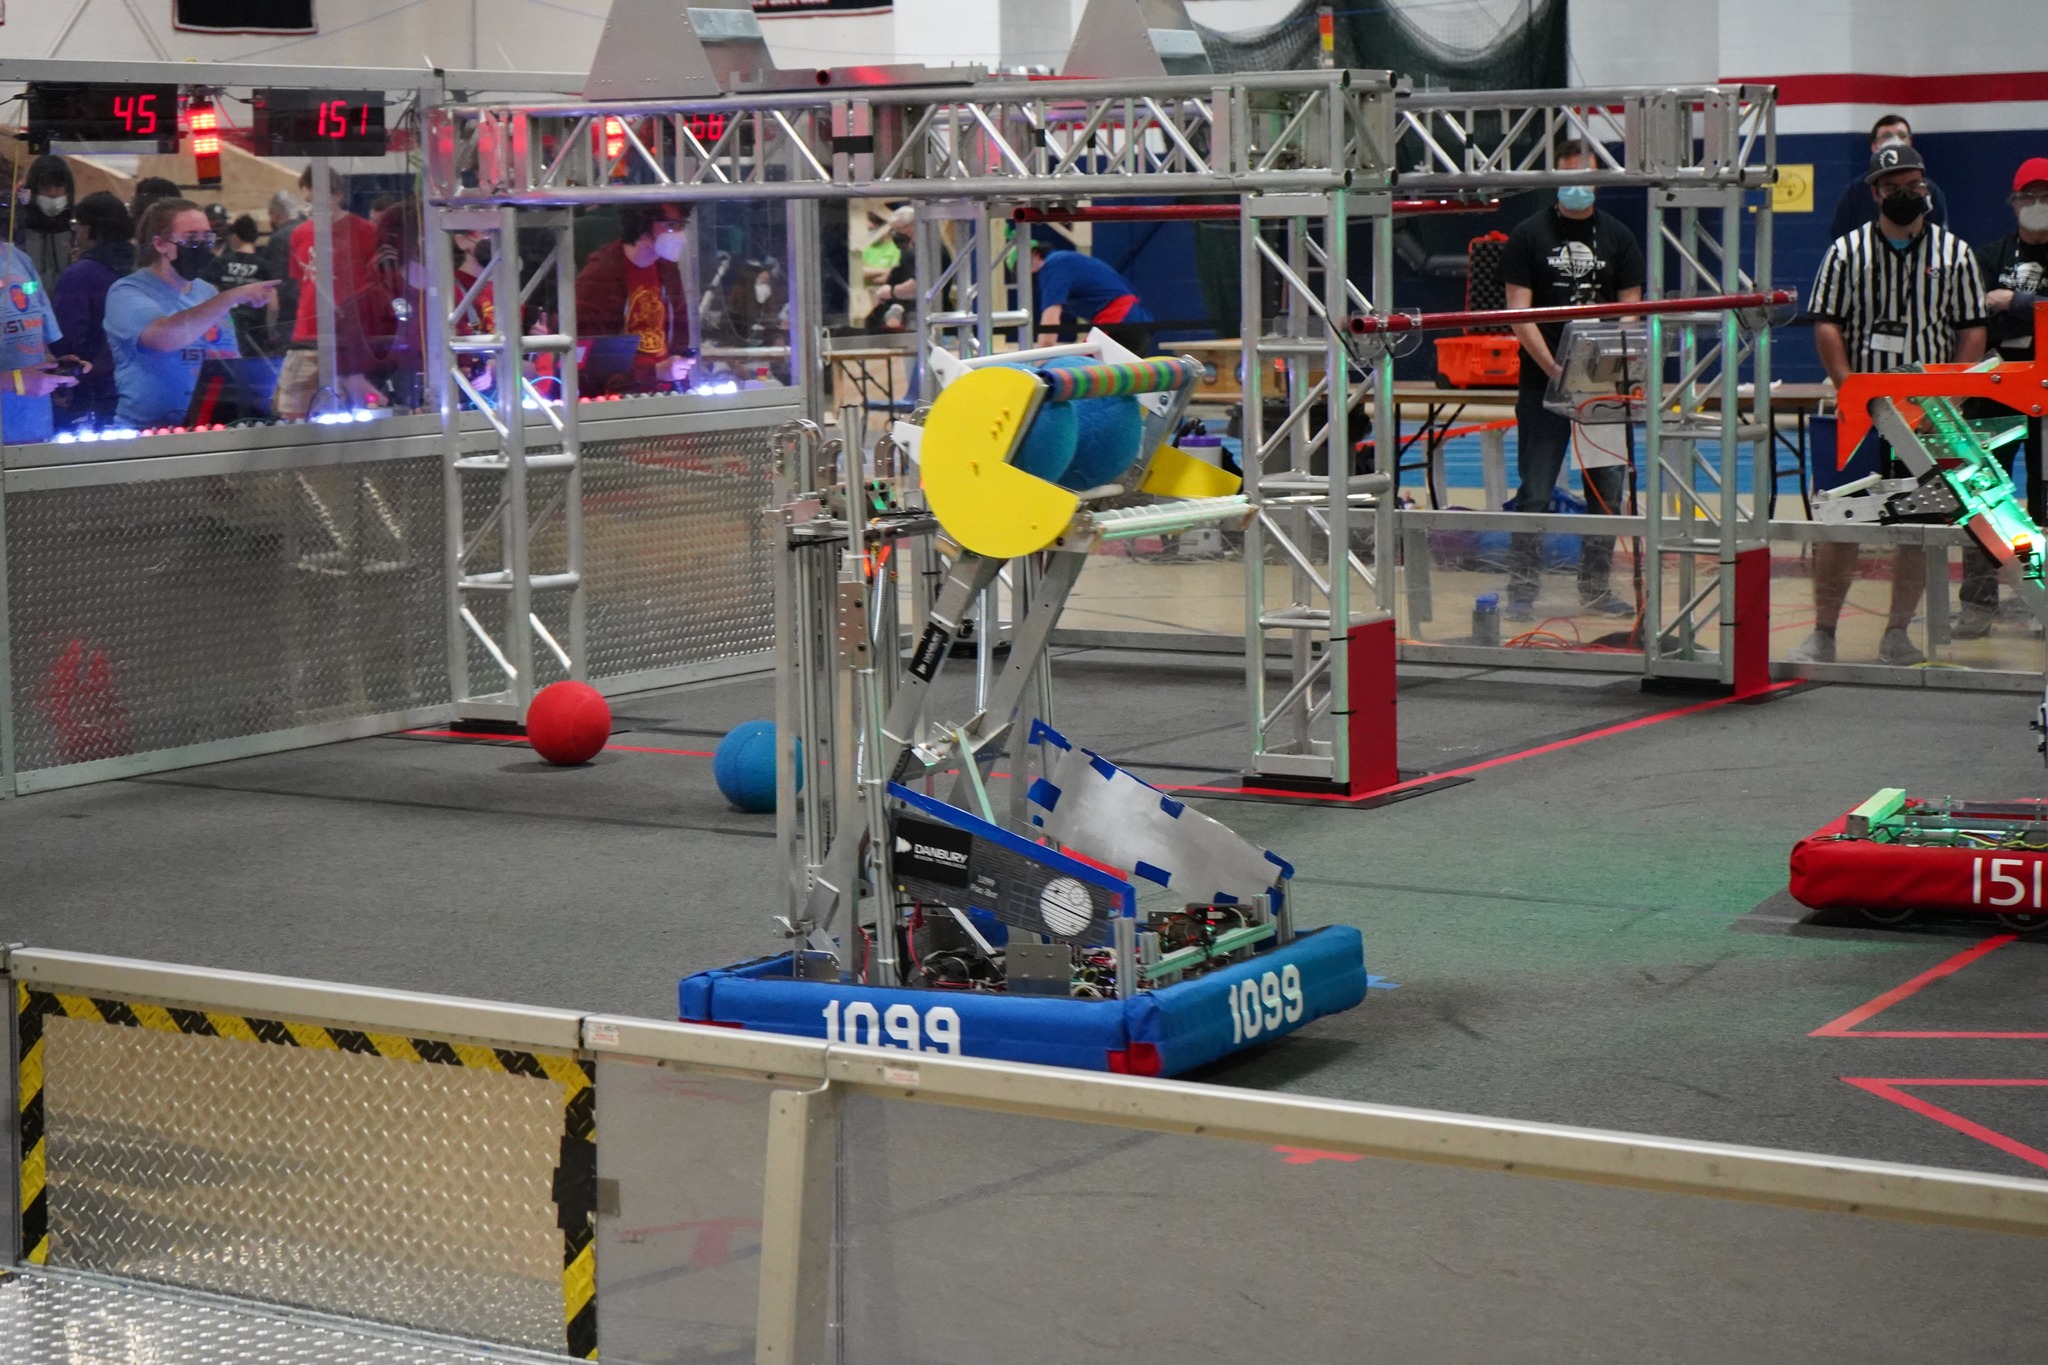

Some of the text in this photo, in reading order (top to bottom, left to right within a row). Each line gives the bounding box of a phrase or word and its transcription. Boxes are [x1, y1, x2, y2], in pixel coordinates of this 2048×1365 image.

[113, 95, 157, 134] 45
[318, 101, 368, 138] 151
[913, 843, 969, 864] DANBURY
[1973, 857, 2043, 908] 151
[1228, 963, 1304, 1044] 1099
[822, 1000, 962, 1056] 1099
